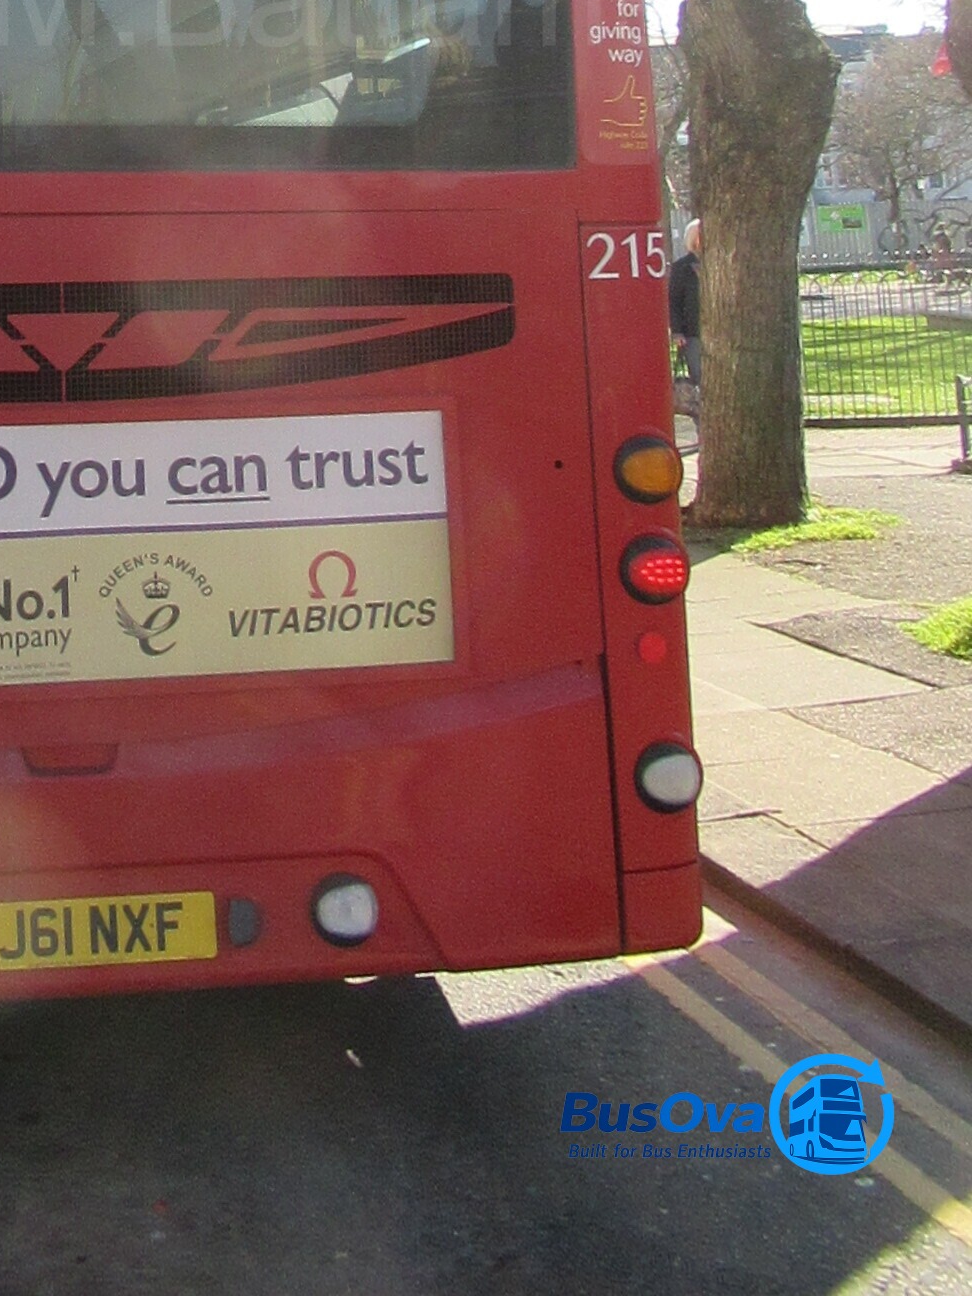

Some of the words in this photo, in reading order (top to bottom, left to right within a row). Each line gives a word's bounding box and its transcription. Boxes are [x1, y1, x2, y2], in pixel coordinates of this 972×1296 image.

[616, 0, 639, 18] for
[589, 21, 642, 44] giving
[608, 49, 644, 67] way
[586, 231, 667, 279] 215
[37, 458, 146, 518] you
[167, 452, 269, 497] can
[285, 440, 428, 489] trust
[99, 552, 160, 598] QUEEN'S
[163, 554, 213, 597] AWARD
[229, 598, 436, 638] VITABIOTICS
[89, 901, 183, 954] NXF
